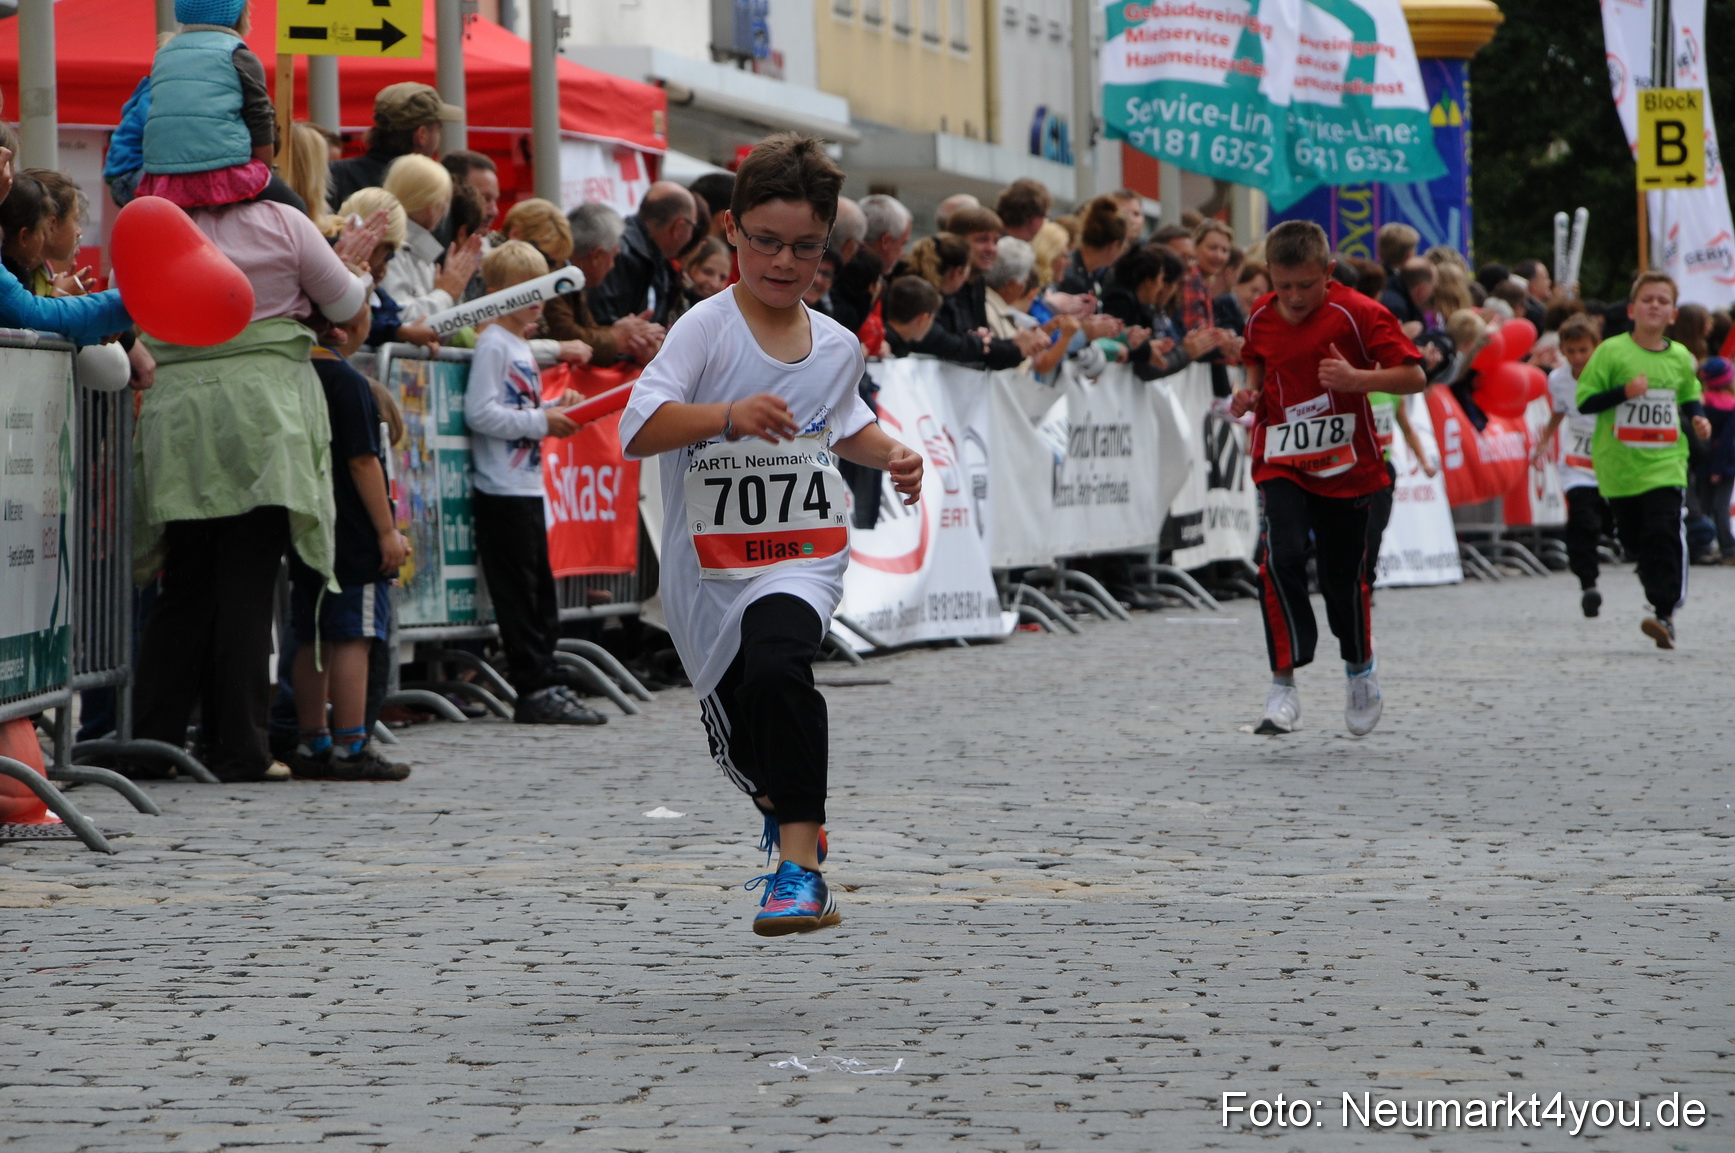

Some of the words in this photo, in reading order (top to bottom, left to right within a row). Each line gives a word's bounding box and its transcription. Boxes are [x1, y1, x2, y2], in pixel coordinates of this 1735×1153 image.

[1644, 92, 1697, 112] Block
[1656, 120, 1688, 167] B
[1625, 403, 1672, 425] 7066
[1277, 416, 1345, 451] 7078
[689, 456, 742, 473] PARTL
[745, 452, 816, 468] Neumarkt
[704, 471, 831, 526] 7074
[745, 539, 800, 562] Elias
